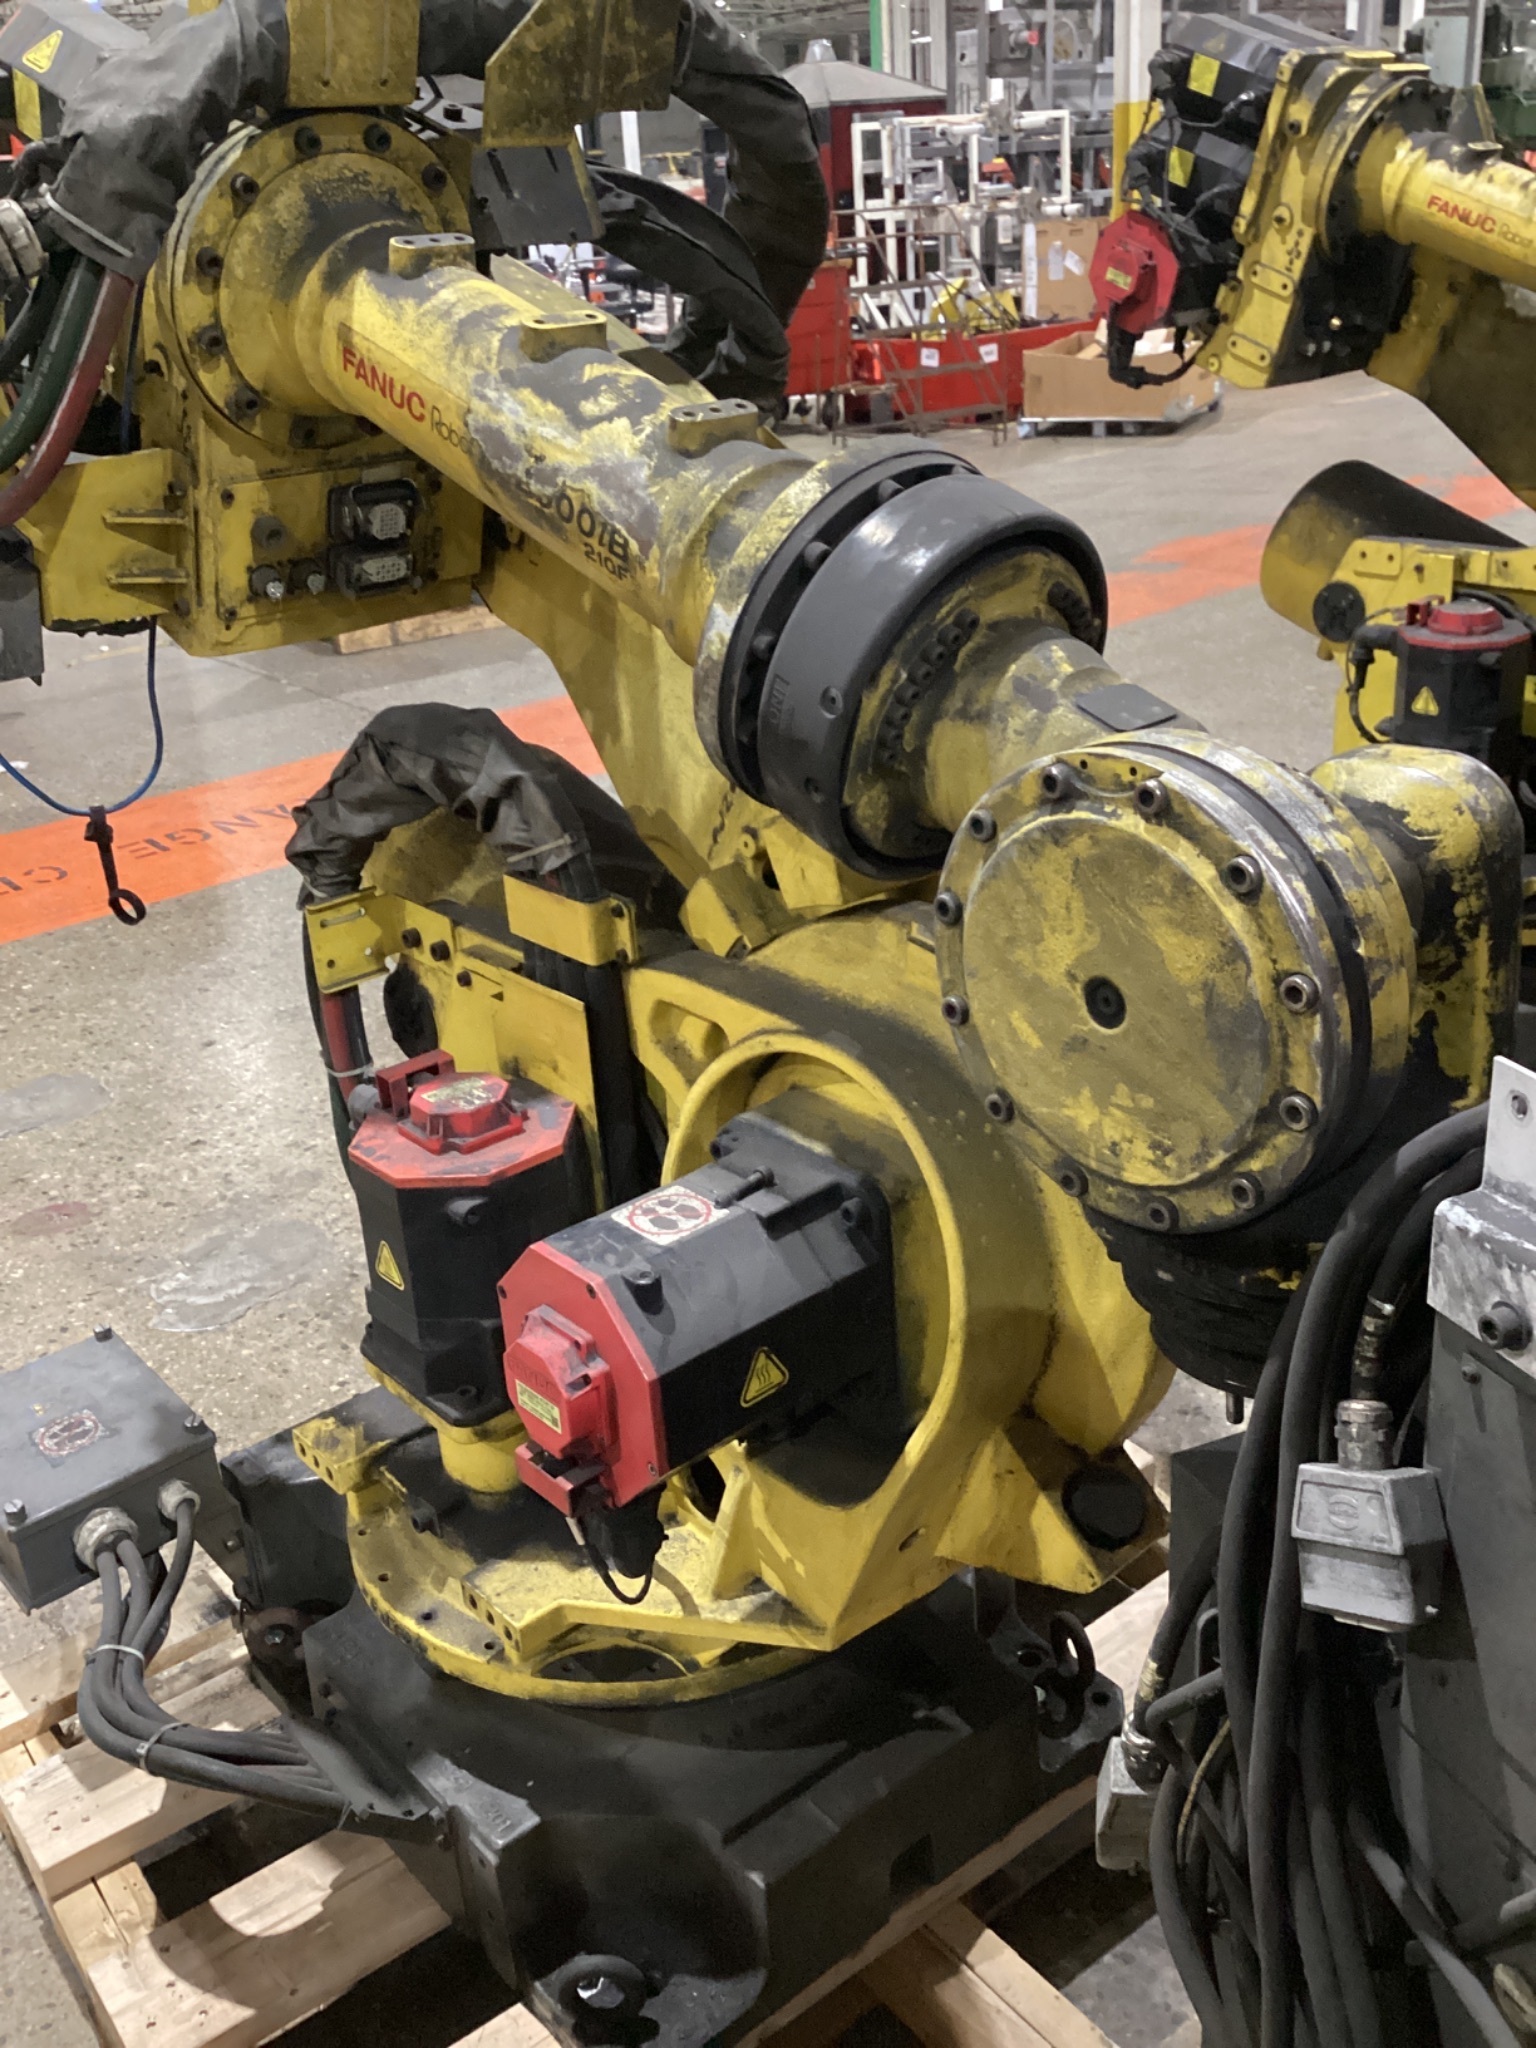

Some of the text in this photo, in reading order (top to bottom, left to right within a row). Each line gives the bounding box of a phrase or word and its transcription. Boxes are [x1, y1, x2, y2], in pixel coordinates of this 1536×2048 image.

[1426, 194, 1497, 234] FANUC
[342, 346, 426, 423] FANUC
[117, 802, 295, 860] ANGE
